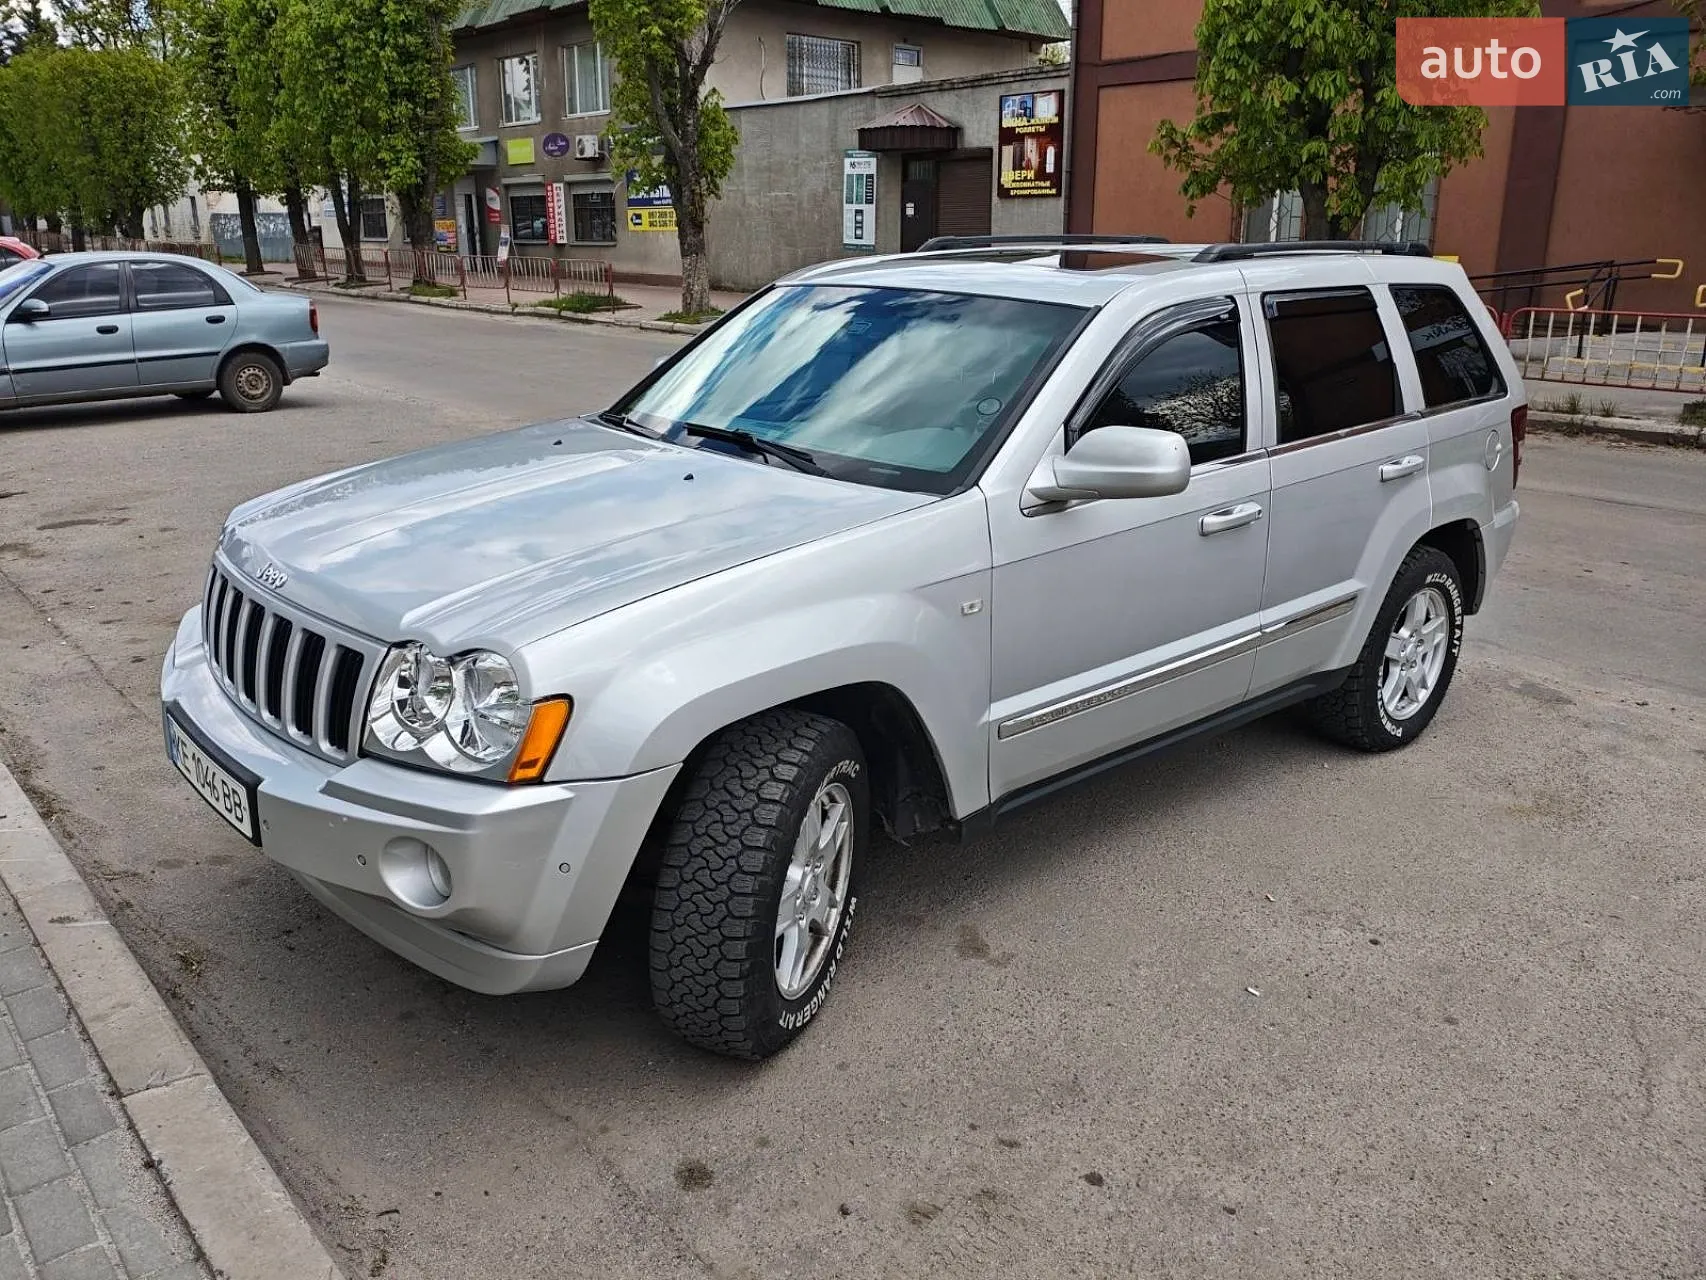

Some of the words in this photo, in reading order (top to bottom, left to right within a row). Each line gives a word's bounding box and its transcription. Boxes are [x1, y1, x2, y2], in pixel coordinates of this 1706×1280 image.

[1001, 170, 1035, 182] ДВЕРИ
[256, 562, 288, 590] Jeep
[191, 752, 220, 803] 1046
[221, 779, 244, 824] BB
